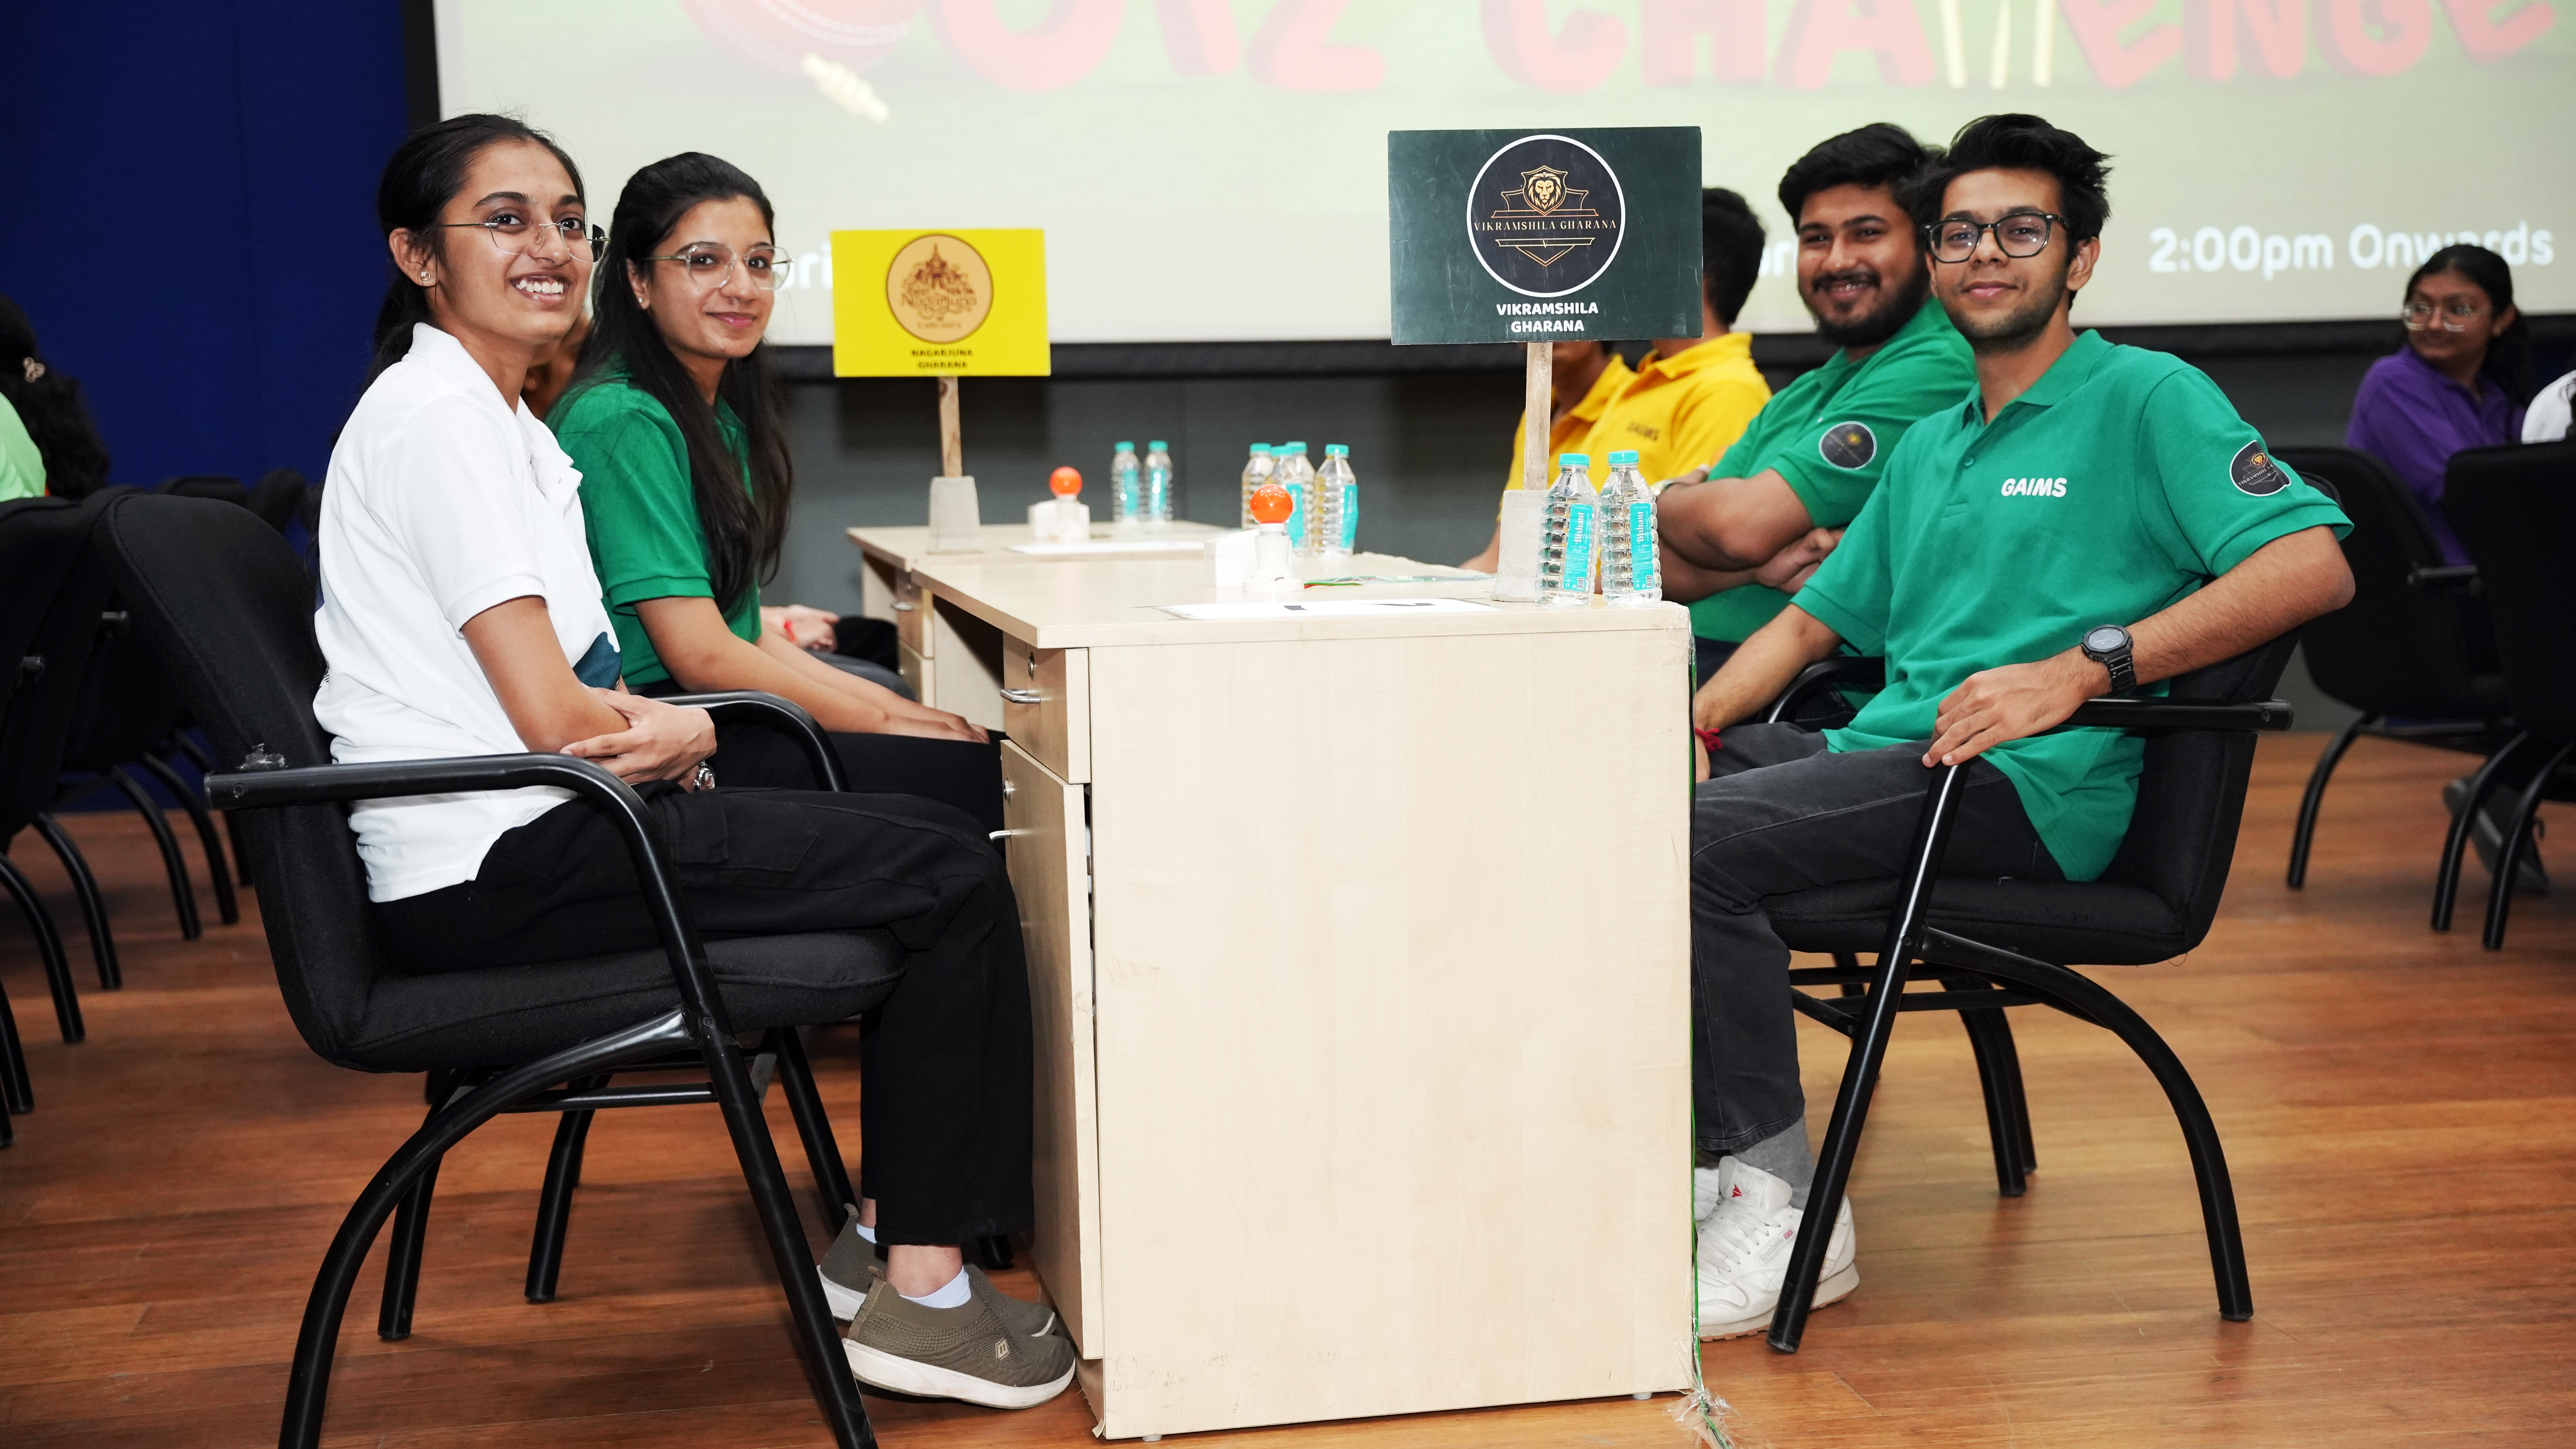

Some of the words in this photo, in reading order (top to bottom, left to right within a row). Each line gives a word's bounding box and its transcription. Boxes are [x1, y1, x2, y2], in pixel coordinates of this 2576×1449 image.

[1474, 221, 1556, 231] VIKRAMSHILA
[1560, 220, 1617, 229] GHARANA
[2148, 225, 2334, 281] 2:00pm
[1496, 302, 1599, 316] VIKRAMSHILA
[1511, 320, 1585, 333] GHARANA
[2001, 477, 2067, 498] GAIMS
